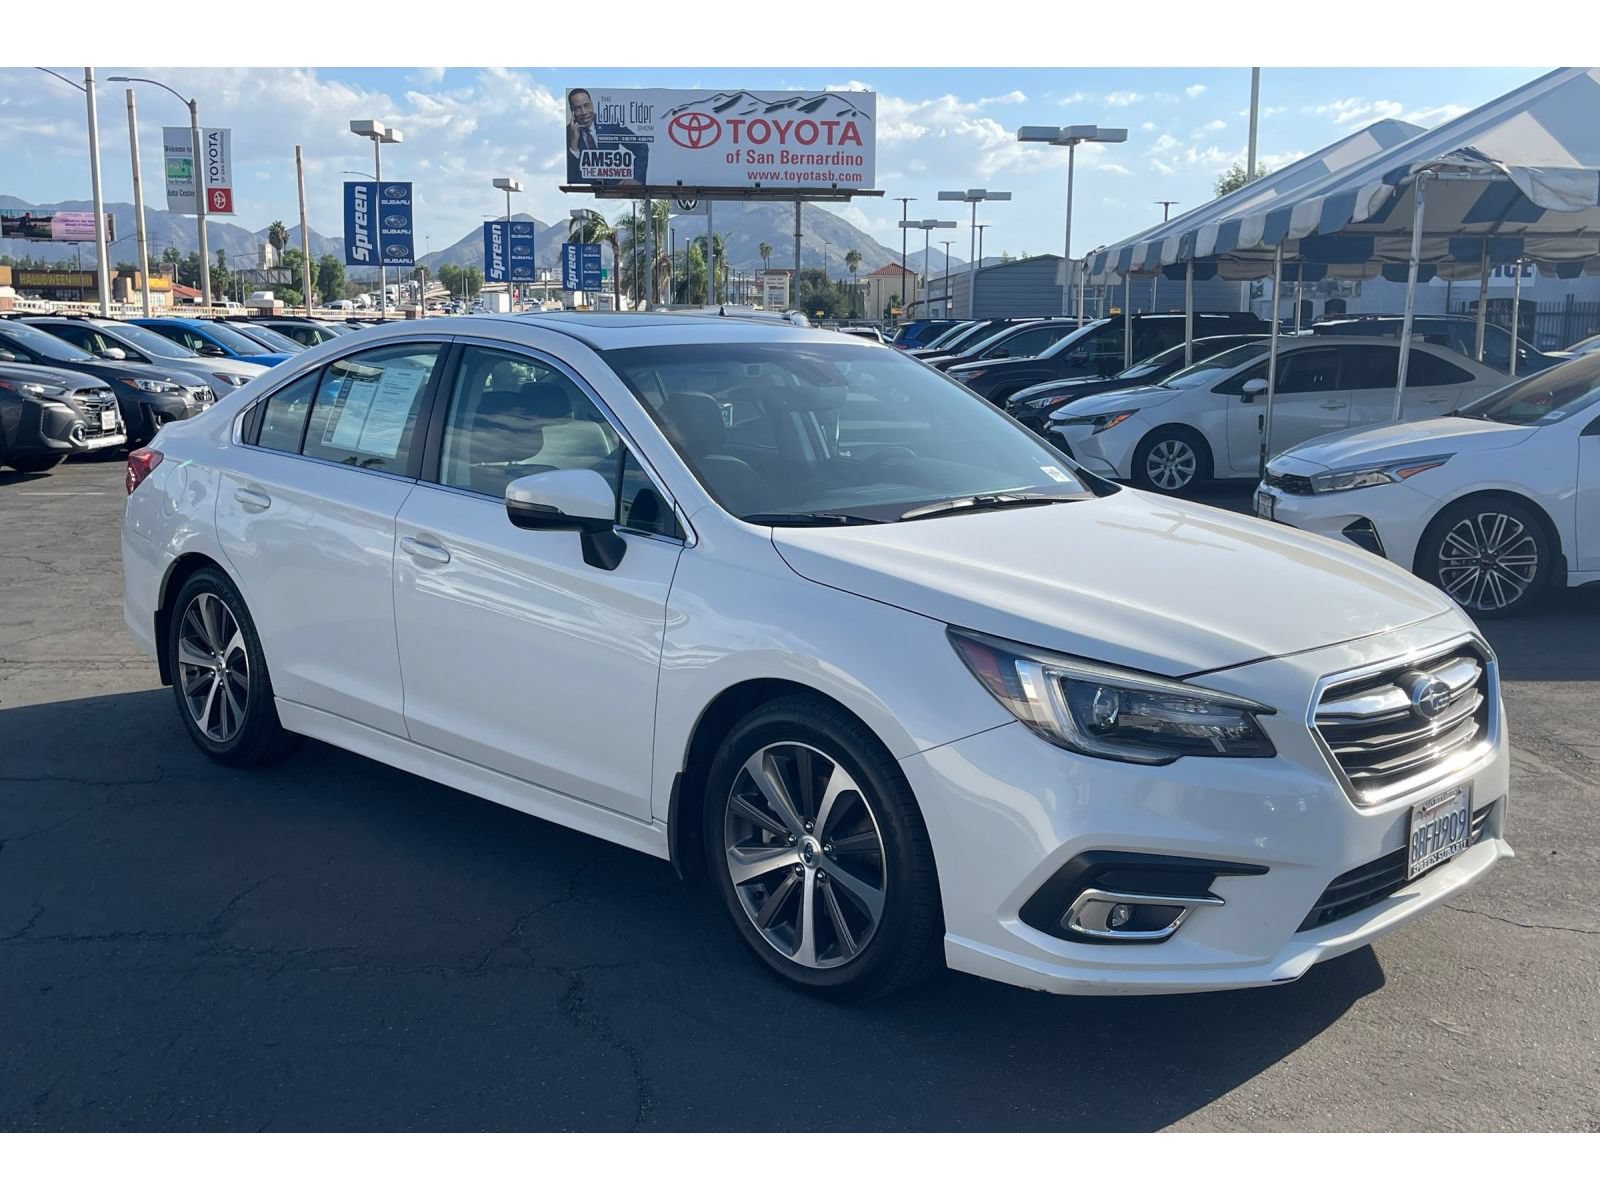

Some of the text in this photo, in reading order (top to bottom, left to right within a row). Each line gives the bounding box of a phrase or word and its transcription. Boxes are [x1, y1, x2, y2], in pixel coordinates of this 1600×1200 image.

[597, 101, 654, 126] Larry Elder
[726, 119, 863, 146] TOYOTA
[208, 132, 220, 184] TOYOTA
[582, 151, 632, 168] AM590
[726, 149, 863, 167] of San Bernardino
[598, 168, 632, 177] ANSWER
[747, 170, 862, 183] www.toyotasb.com
[352, 185, 373, 262] Spreen
[490, 224, 506, 280] Spreen
[566, 245, 579, 290] Spreen
[1412, 839, 1467, 874] SPREEN SUBARU
